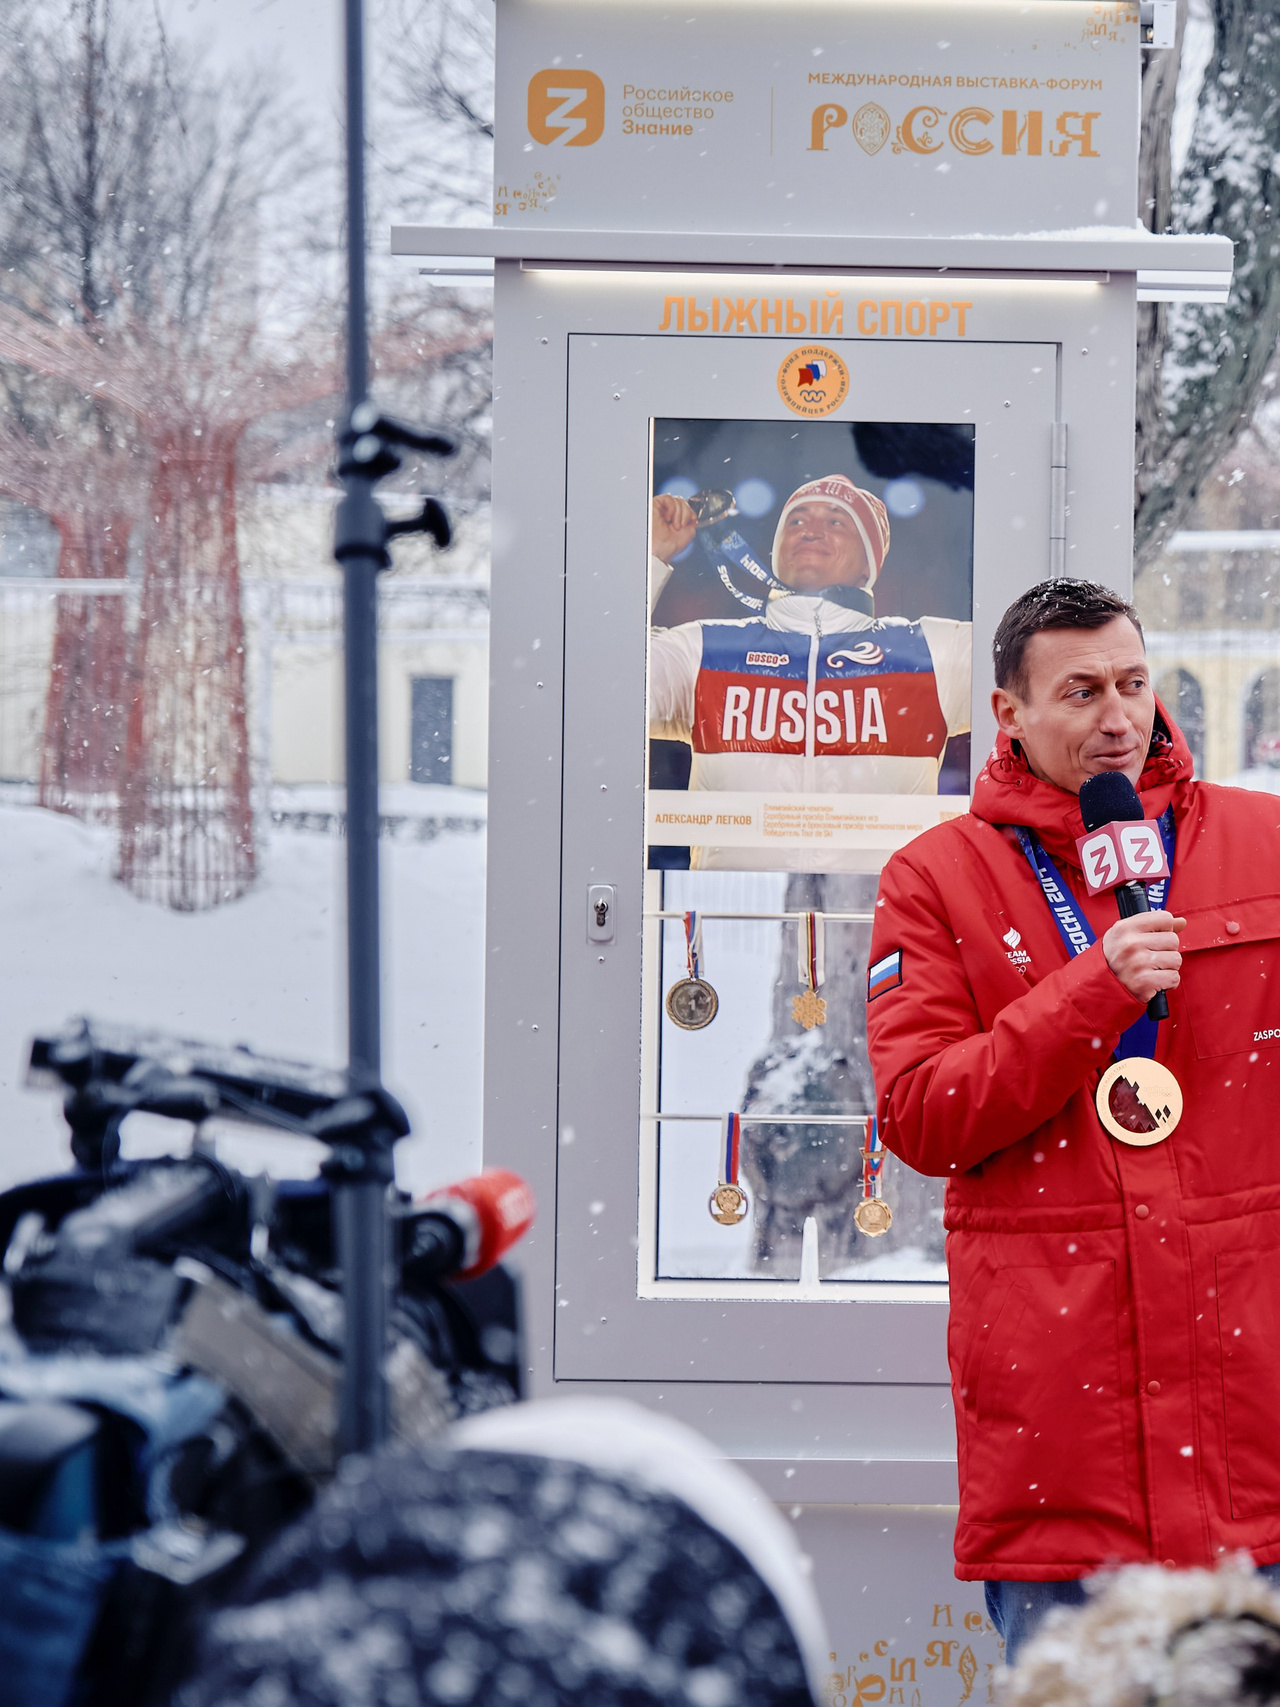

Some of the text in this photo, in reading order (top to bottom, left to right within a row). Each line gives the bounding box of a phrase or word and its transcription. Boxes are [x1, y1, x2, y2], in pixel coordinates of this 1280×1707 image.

[808, 72, 1103, 91] МЕЖДУНАРОДНАЯ ВЫСТАВКА-ФОРУМ
[623, 84, 734, 103] Российское
[621, 103, 714, 120] общество
[621, 119, 694, 136] Знание
[806, 101, 1102, 157] РОССИЯ
[658, 289, 973, 336] ЛЫЖНЫЙ СПОРТ
[748, 652, 780, 665] BOSCO
[722, 685, 888, 744] RUSSIA
[655, 813, 753, 825] АЛЕКСАНДР ЛЕГКОВ
[1053, 904, 1092, 956] SOCHI
[1004, 949, 1027, 959] EAM
[1009, 955, 1032, 965] SSIA
